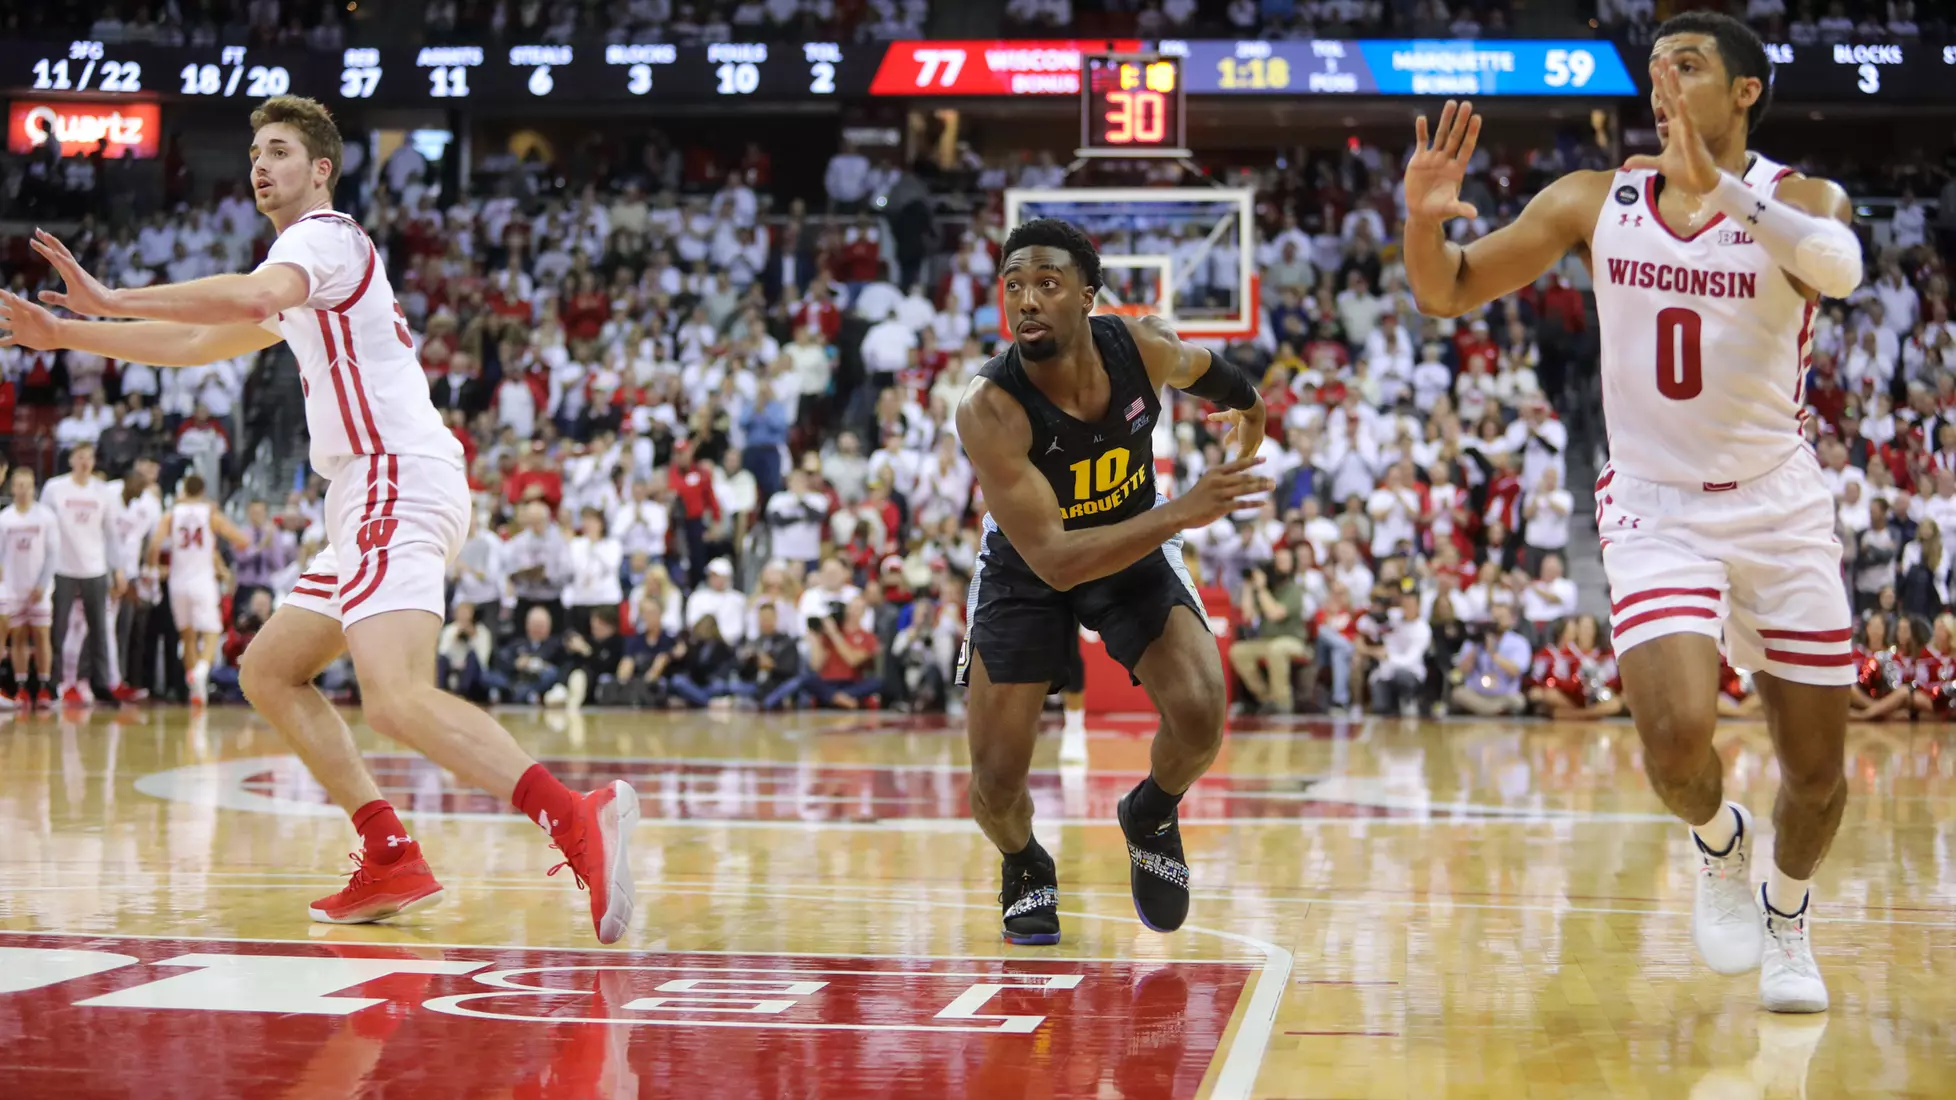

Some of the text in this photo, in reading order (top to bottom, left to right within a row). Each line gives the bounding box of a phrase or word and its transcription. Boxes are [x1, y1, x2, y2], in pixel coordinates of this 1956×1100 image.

[509, 45, 573, 66] STEALS
[605, 44, 677, 65] BLOCKS
[707, 43, 767, 64] FOULS
[912, 49, 967, 88] 77
[984, 48, 1081, 72] WISCON
[1392, 50, 1516, 73] MARQUETTE
[1543, 49, 1596, 88] 59
[1833, 44, 1903, 65] BLOCKS
[340, 67, 382, 98] 37
[429, 66, 470, 97] 11
[528, 65, 554, 96] 6
[627, 64, 653, 96] 3
[716, 63, 760, 95] 10
[810, 63, 836, 94] 2
[1011, 74, 1080, 95] BONUS
[1217, 56, 1289, 90] 1:18
[1412, 73, 1480, 95] BONUS
[1857, 63, 1881, 94] 3
[24, 104, 144, 146] Quartz
[1104, 92, 1166, 144] 30
[1607, 258, 1757, 299] WISCONSIN
[1656, 307, 1703, 401] 0
[1069, 447, 1130, 500] 10
[1060, 463, 1146, 520] ARQUETTE
[178, 526, 203, 549] 34
